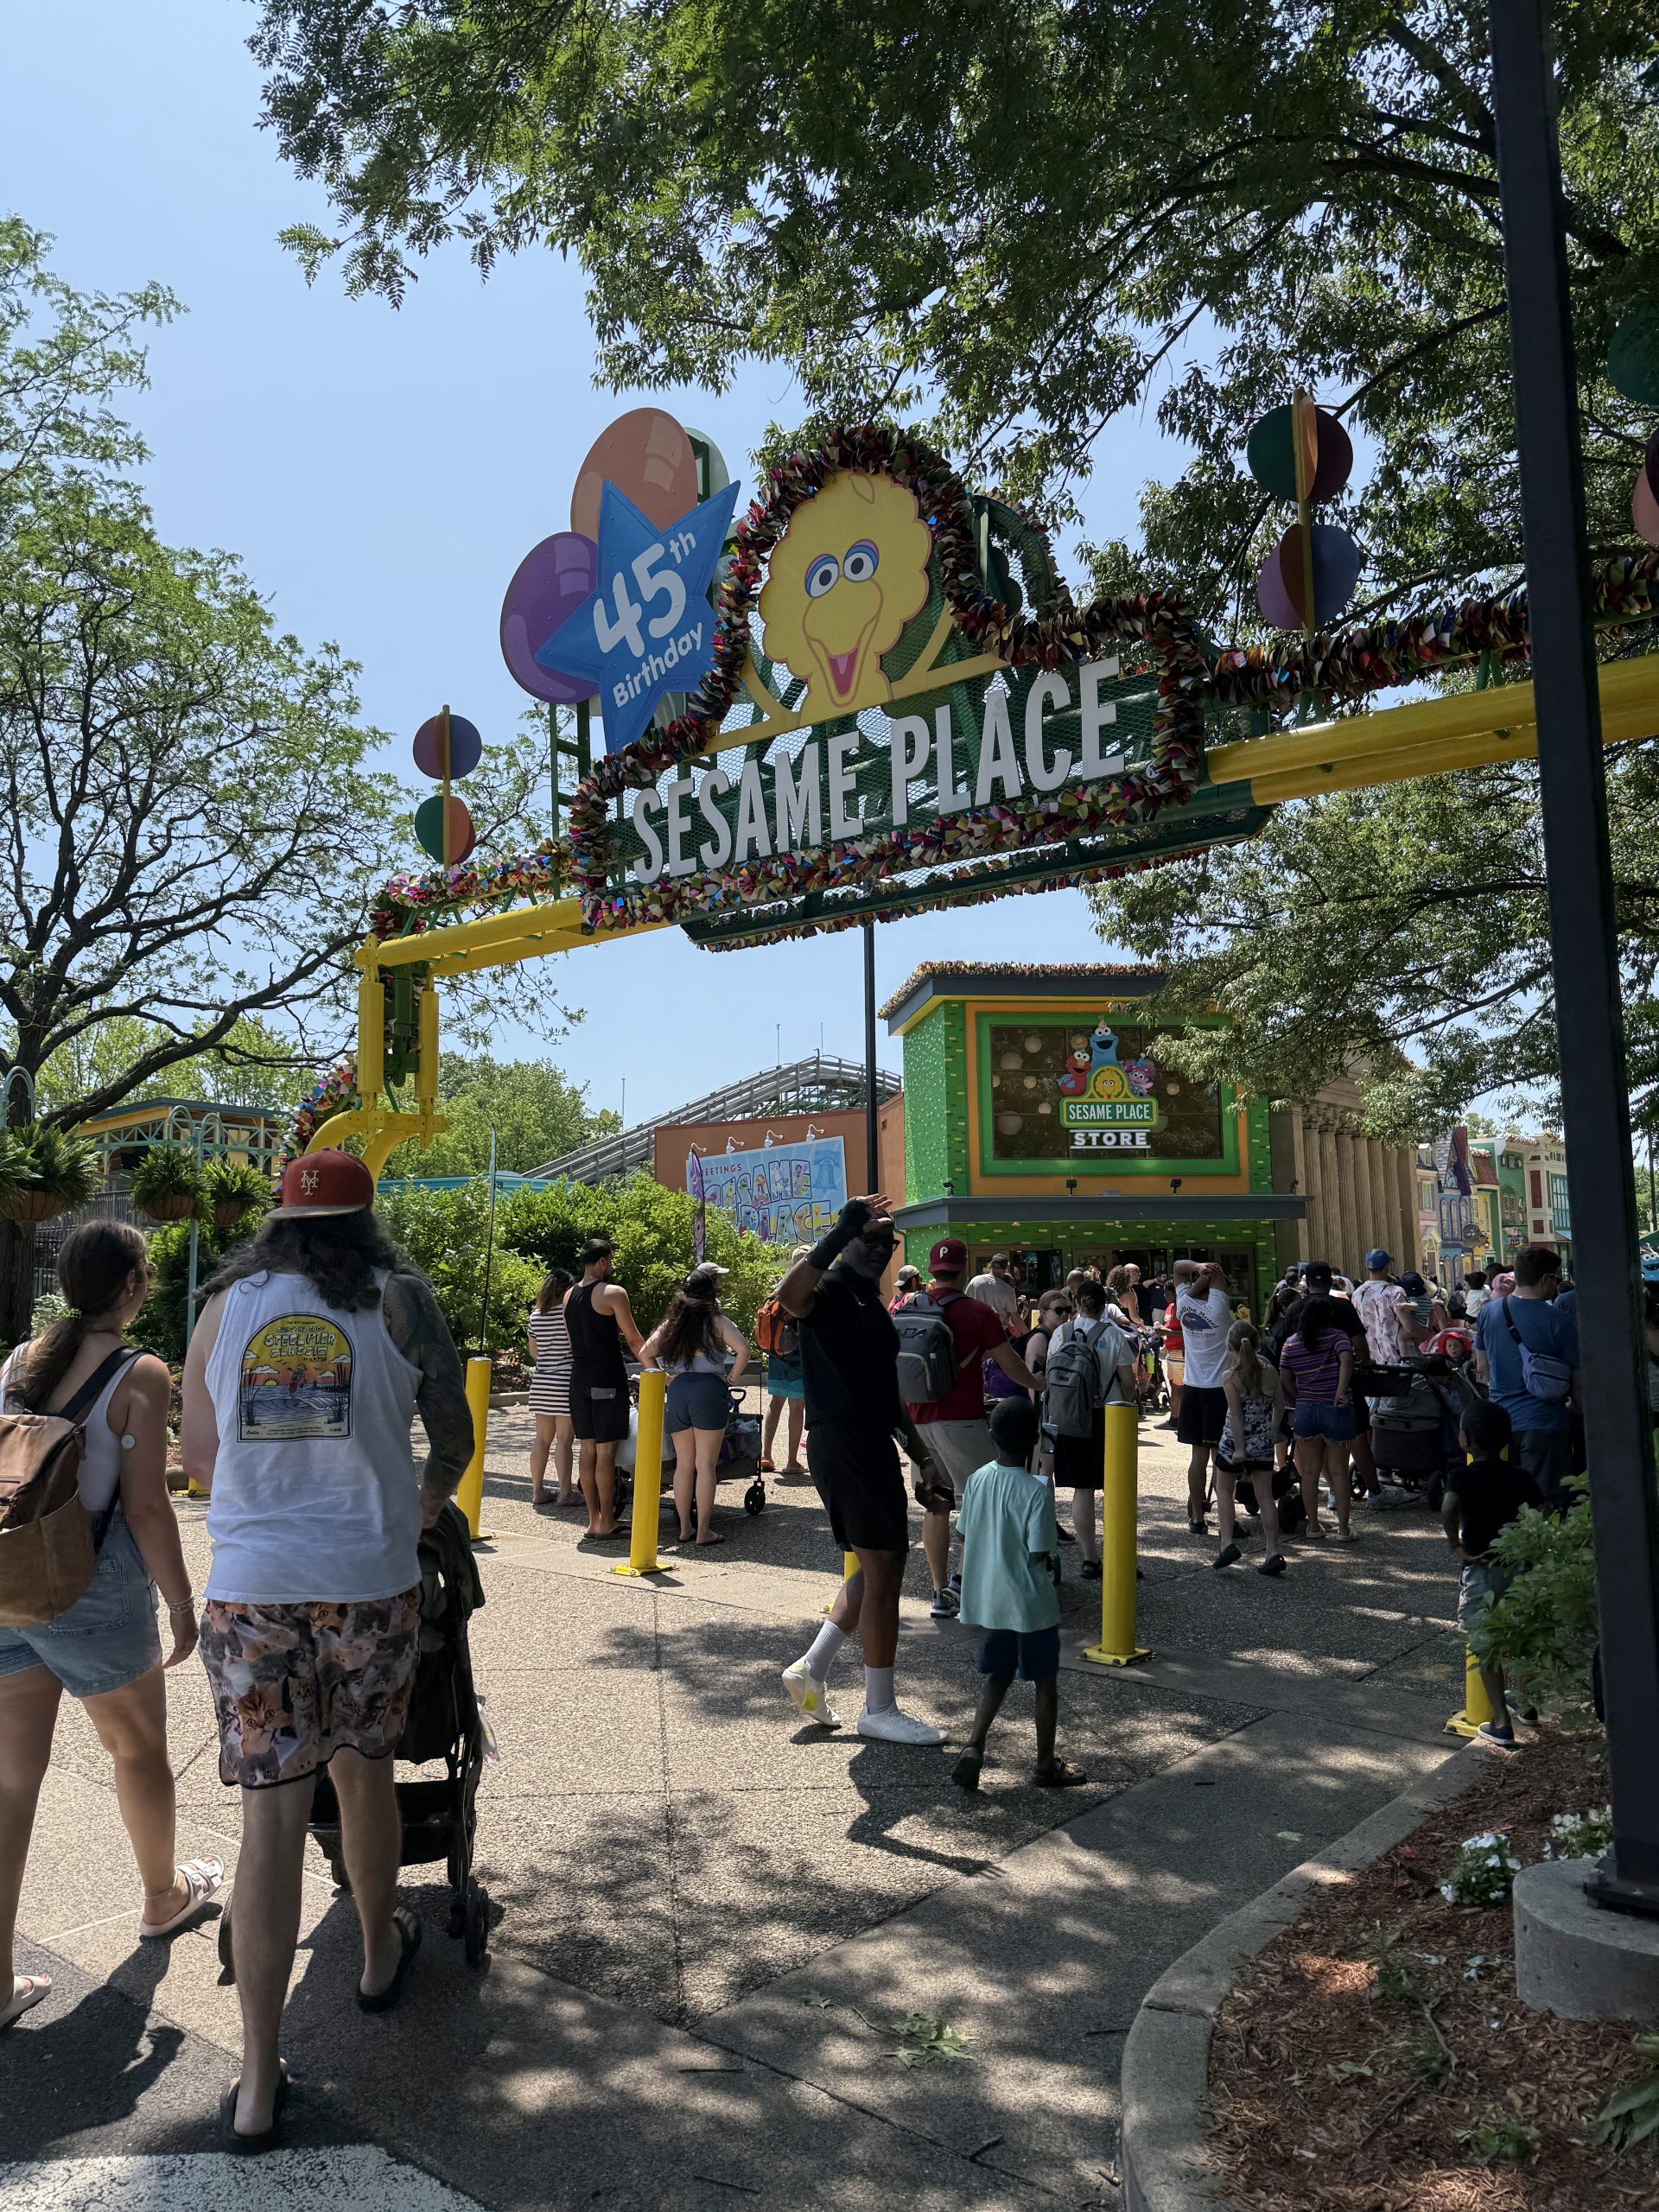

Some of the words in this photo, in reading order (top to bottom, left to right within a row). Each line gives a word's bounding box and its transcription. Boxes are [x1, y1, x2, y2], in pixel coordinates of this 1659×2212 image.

[594, 531, 696, 658] 45th
[613, 622, 702, 708] Birthday
[633, 731, 864, 883] SESAME
[891, 656, 1124, 825] PLACE
[1069, 1104, 1112, 1120] SESAME
[1116, 1104, 1150, 1120] PLACE
[1074, 1132, 1147, 1146] STORE
[701, 1163, 742, 1176] EETINGS
[736, 1201, 831, 1244] PLACE
[939, 1246, 949, 1258] P
[264, 1333, 305, 1347] STEEL
[308, 1332, 335, 1345] PIER
[270, 1346, 327, 1357] CLASSIC
